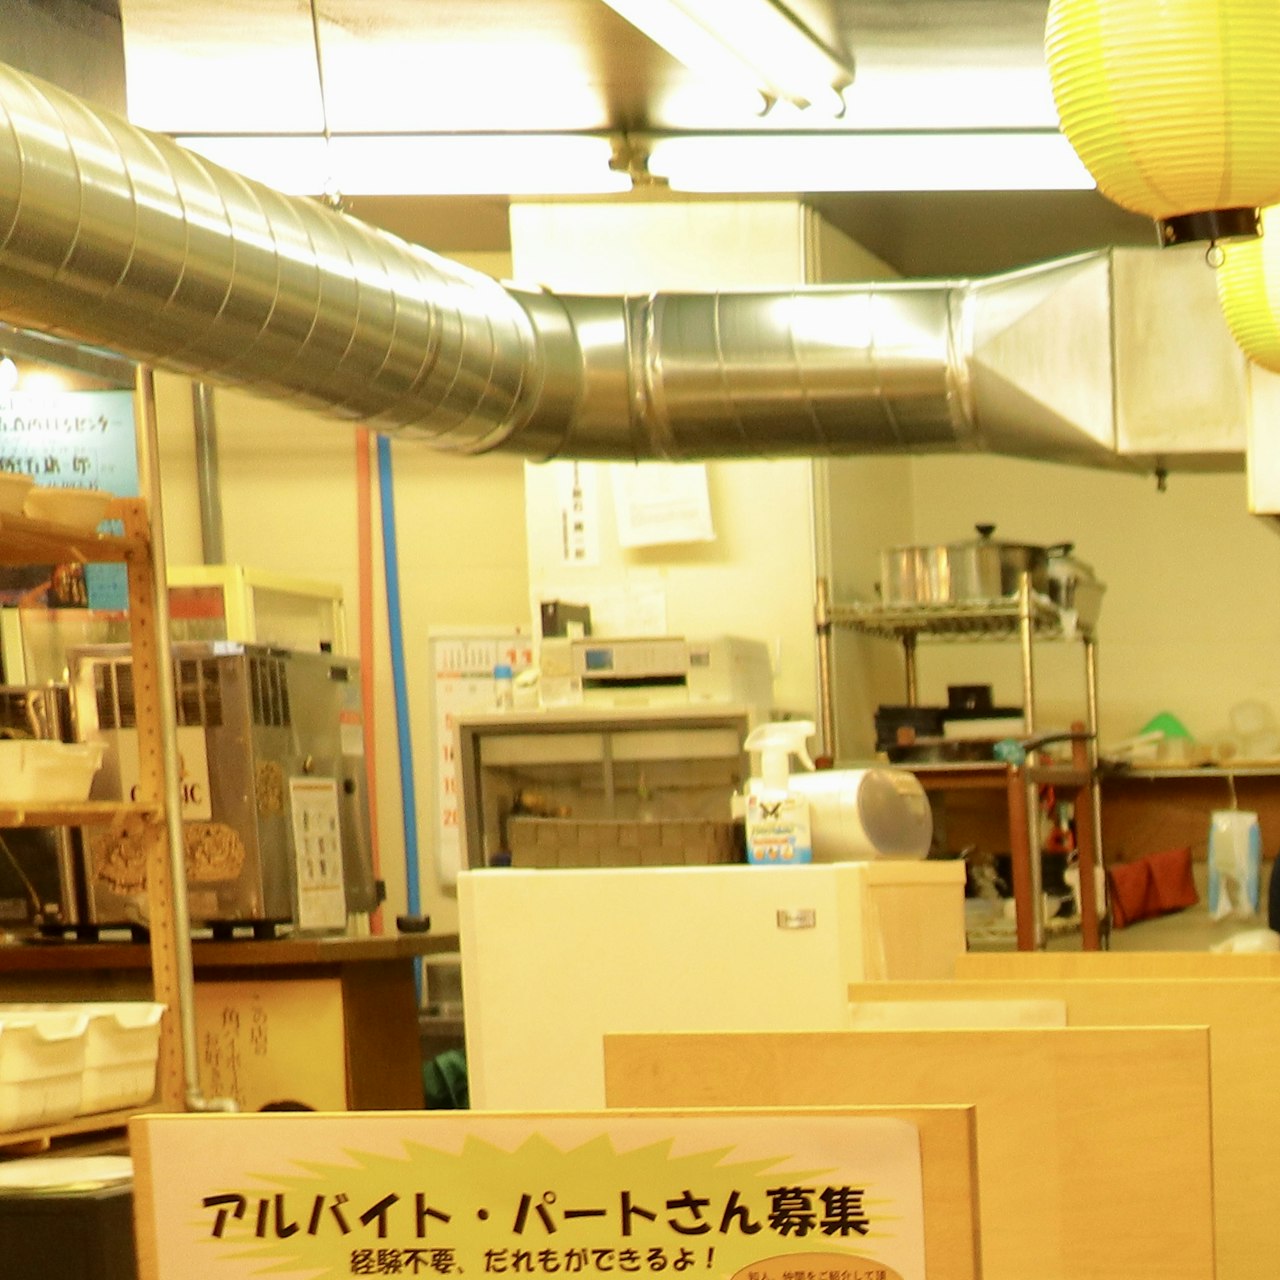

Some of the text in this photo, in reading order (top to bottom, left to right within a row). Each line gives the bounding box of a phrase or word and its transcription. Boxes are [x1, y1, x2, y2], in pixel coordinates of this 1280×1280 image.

[202, 1186, 870, 1240] アルバイト・パートさん募集
[350, 1246, 718, 1276] 経験不要、だれもができるよ！
